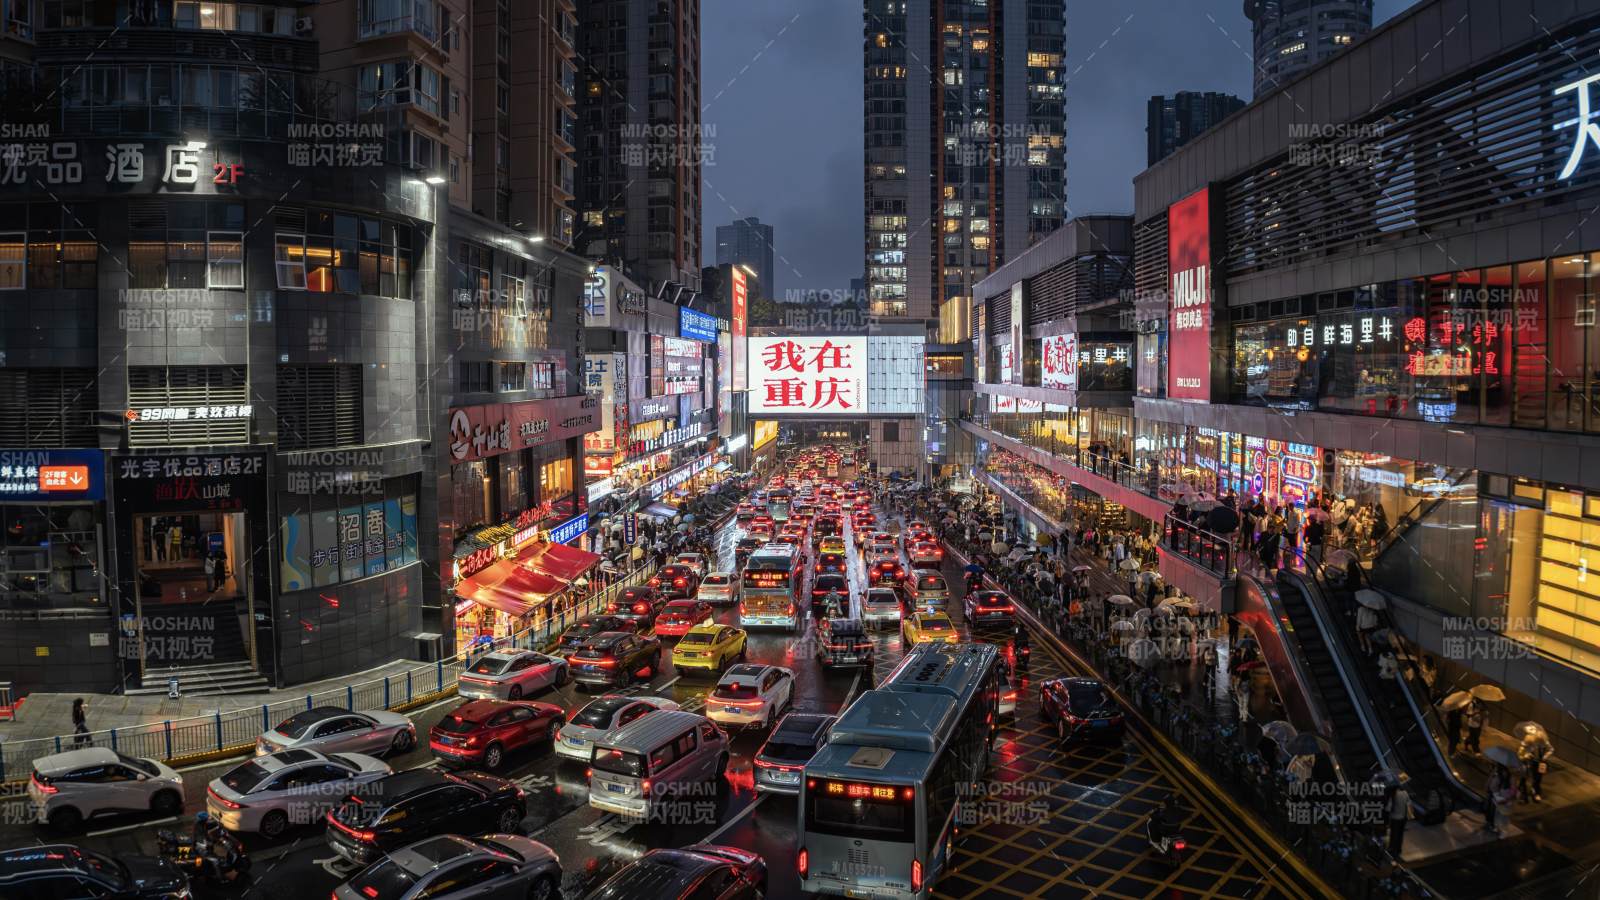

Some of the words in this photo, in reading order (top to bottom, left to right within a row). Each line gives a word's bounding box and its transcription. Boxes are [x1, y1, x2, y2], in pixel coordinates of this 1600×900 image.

[213, 163, 245, 184] 2F
[1173, 265, 1206, 309] MUJI
[762, 340, 851, 374] 我在
[763, 377, 853, 409] 重庆
[341, 509, 384, 542] 招商
